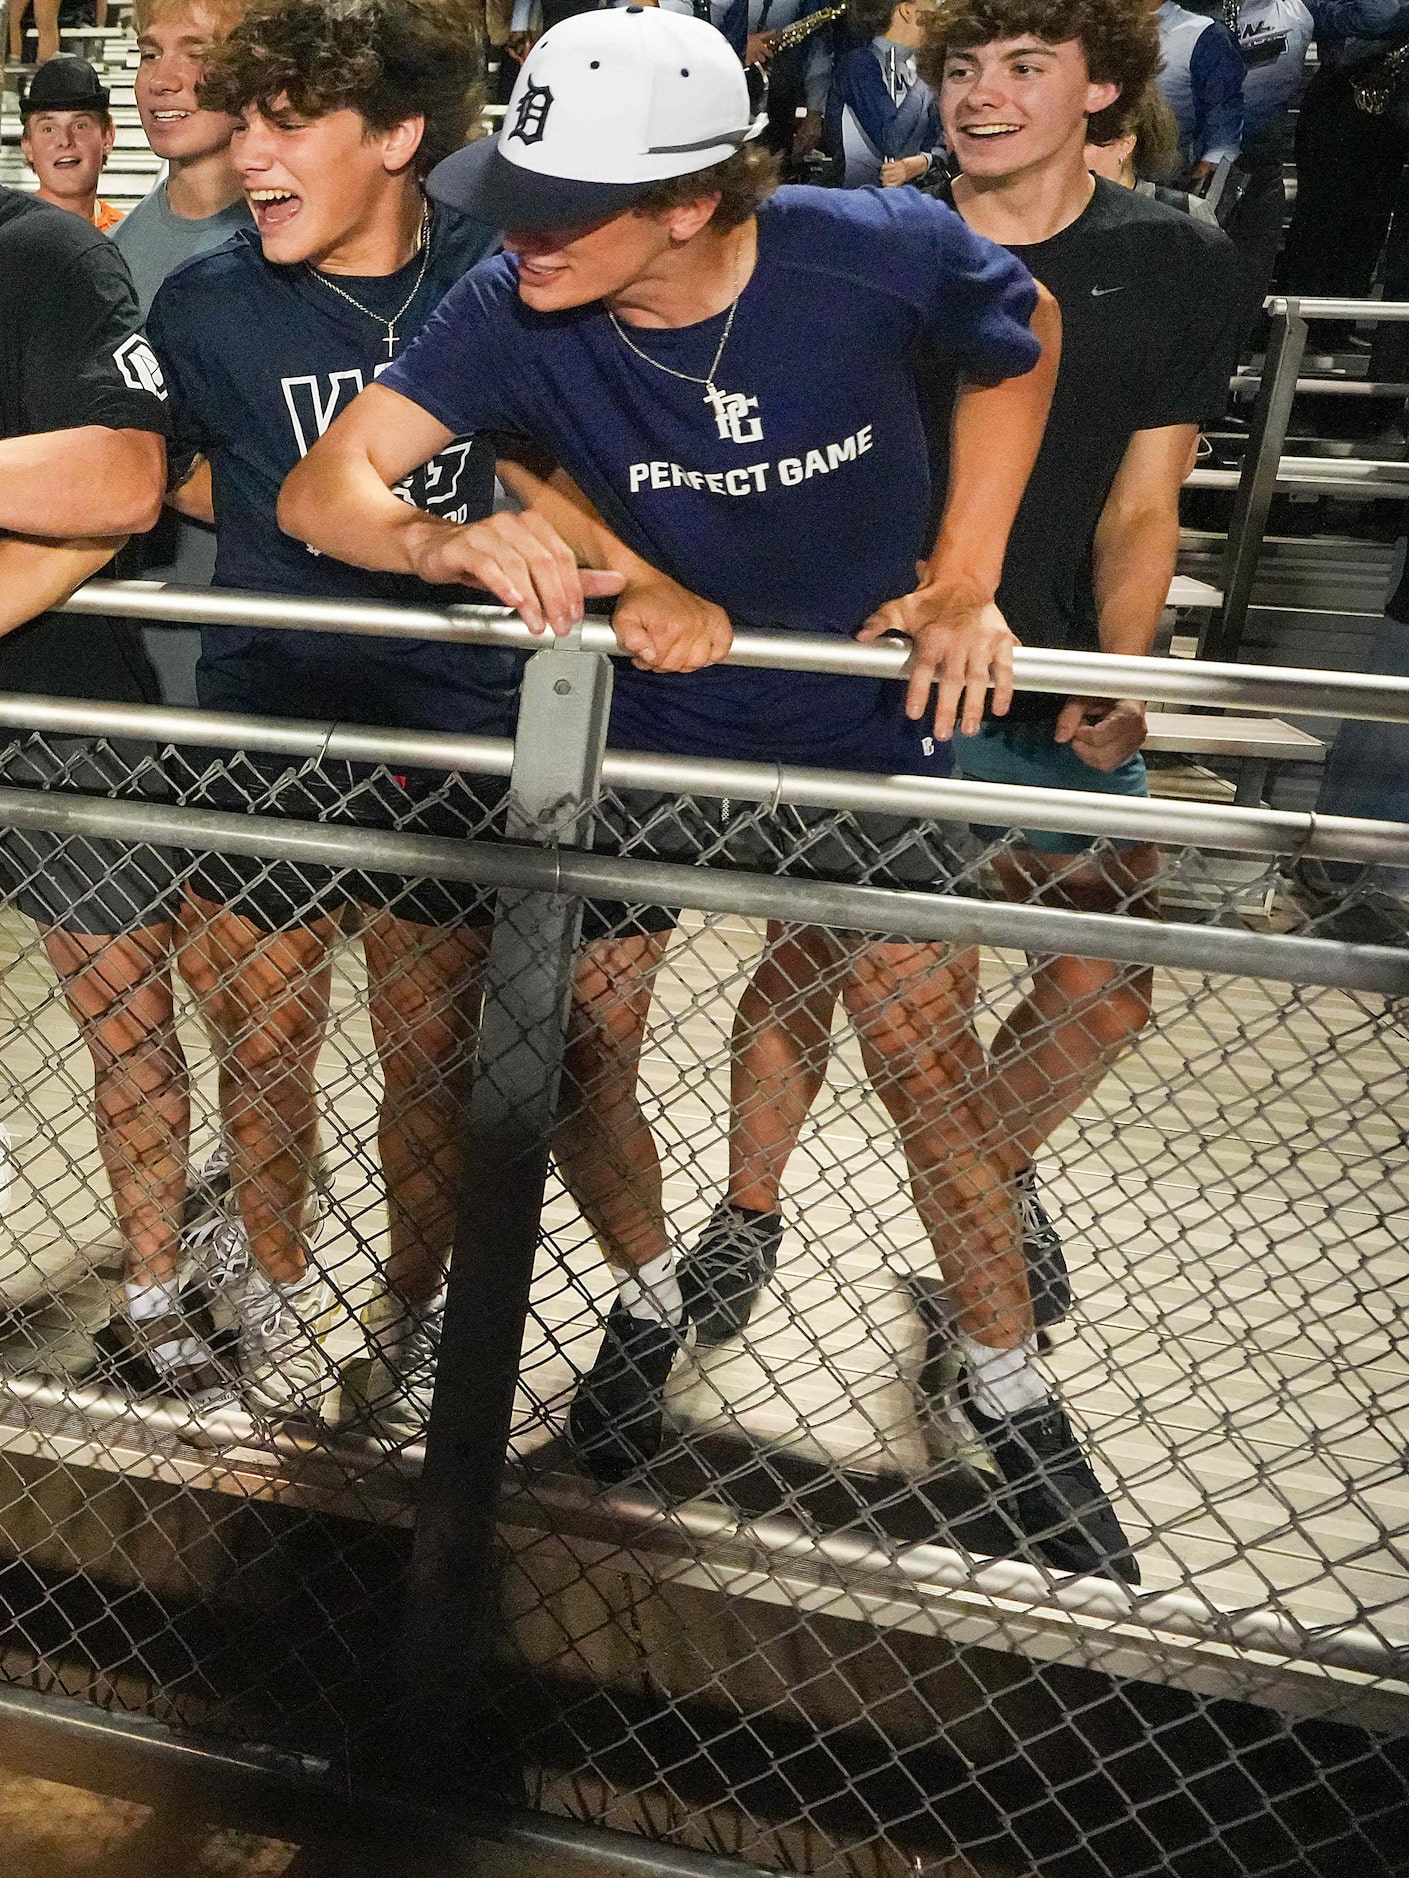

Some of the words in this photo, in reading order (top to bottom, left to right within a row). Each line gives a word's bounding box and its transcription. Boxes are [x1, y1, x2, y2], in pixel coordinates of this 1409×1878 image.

[508, 73, 555, 146] D
[629, 462, 770, 497] PERFECT
[777, 424, 874, 487] GAME
